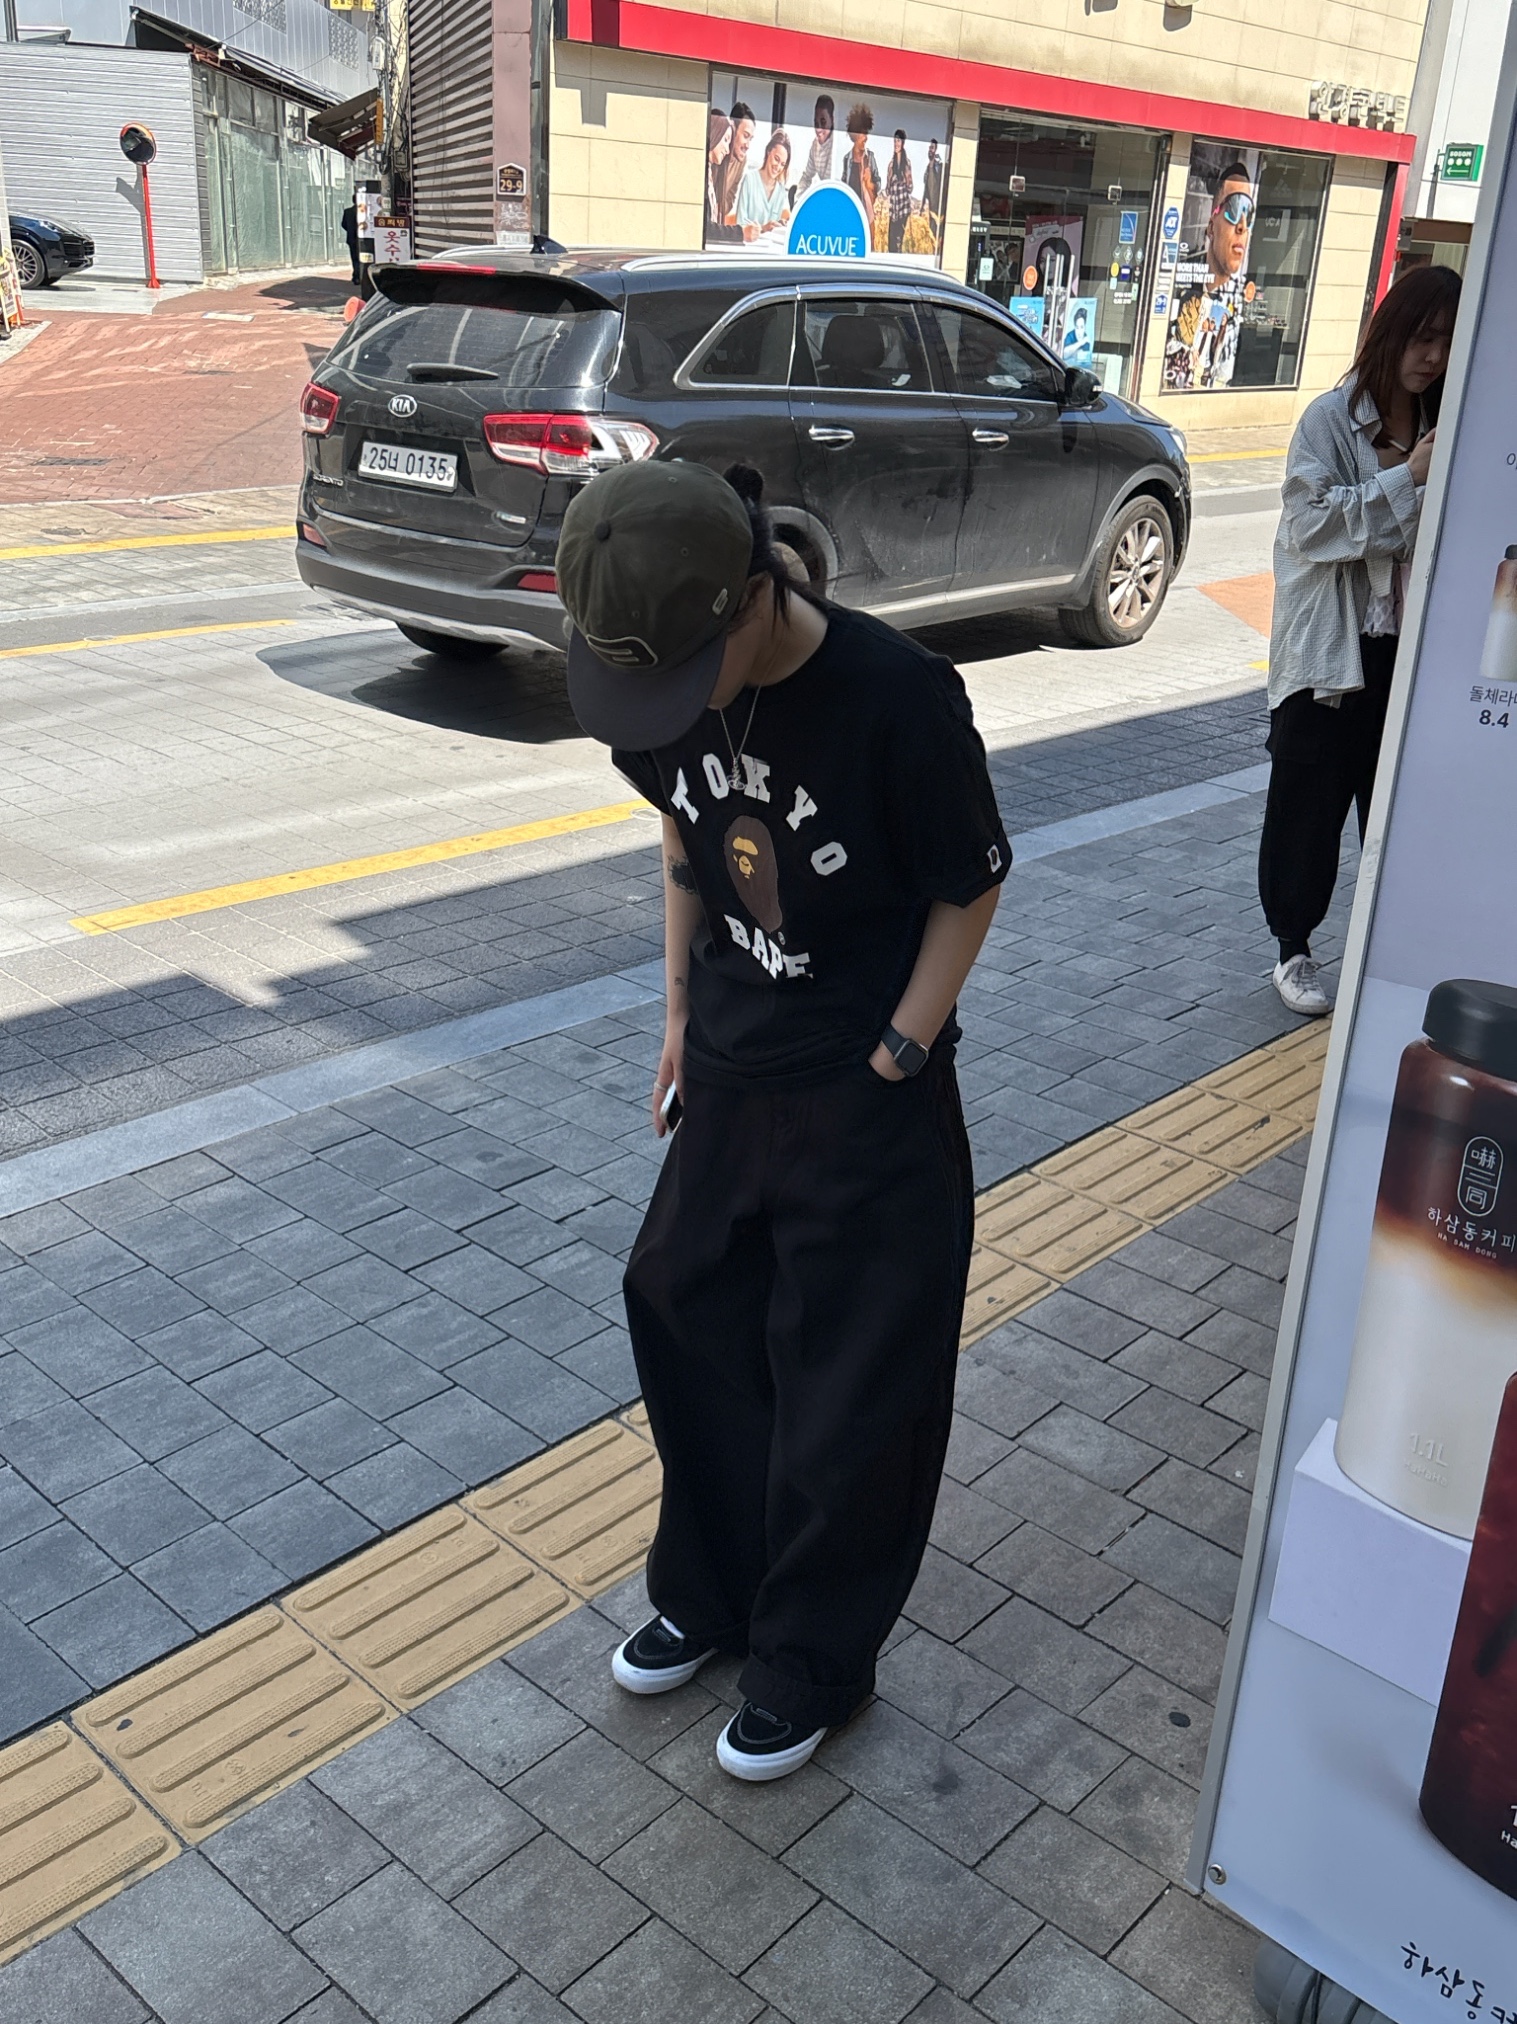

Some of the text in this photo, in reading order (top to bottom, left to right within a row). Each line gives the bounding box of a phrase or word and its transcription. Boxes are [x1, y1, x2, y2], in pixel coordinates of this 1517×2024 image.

[500, 179, 523, 192] 29-9
[383, 230, 402, 263] 옷수
[795, 234, 859, 256] ACUVUE
[391, 398, 411, 413] KIA
[368, 447, 448, 482] 25너 0135
[1479, 709, 1509, 729] 8.4
[671, 752, 848, 877] TOKYO
[723, 913, 814, 980] BAPE
[1427, 1206, 1517, 1253] 하삼동커피
[1437, 1232, 1497, 1259] HA SAM DONG
[1409, 1432, 1448, 1467] 1.1L
